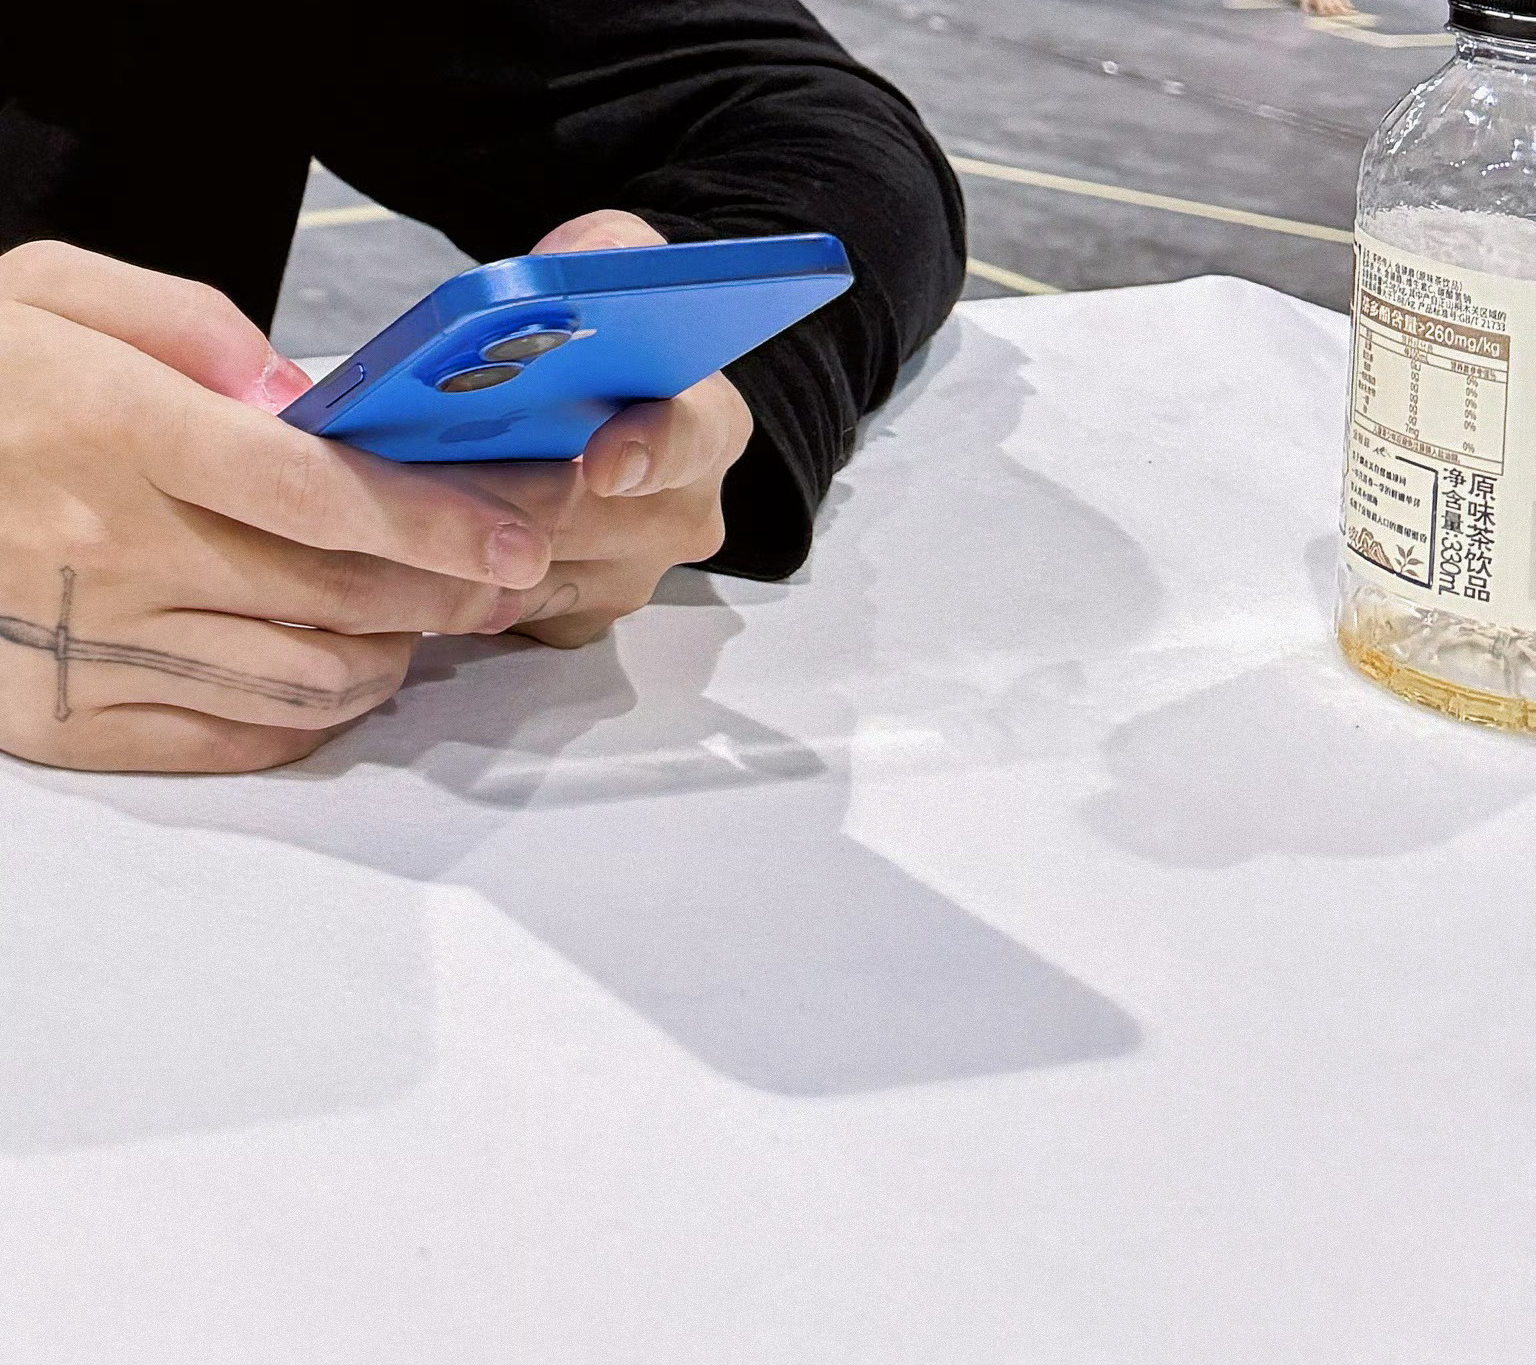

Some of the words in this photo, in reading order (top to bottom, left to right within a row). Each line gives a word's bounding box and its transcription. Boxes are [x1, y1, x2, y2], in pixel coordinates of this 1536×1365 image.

[1464, 473, 1497, 602] 原味茶饮品
